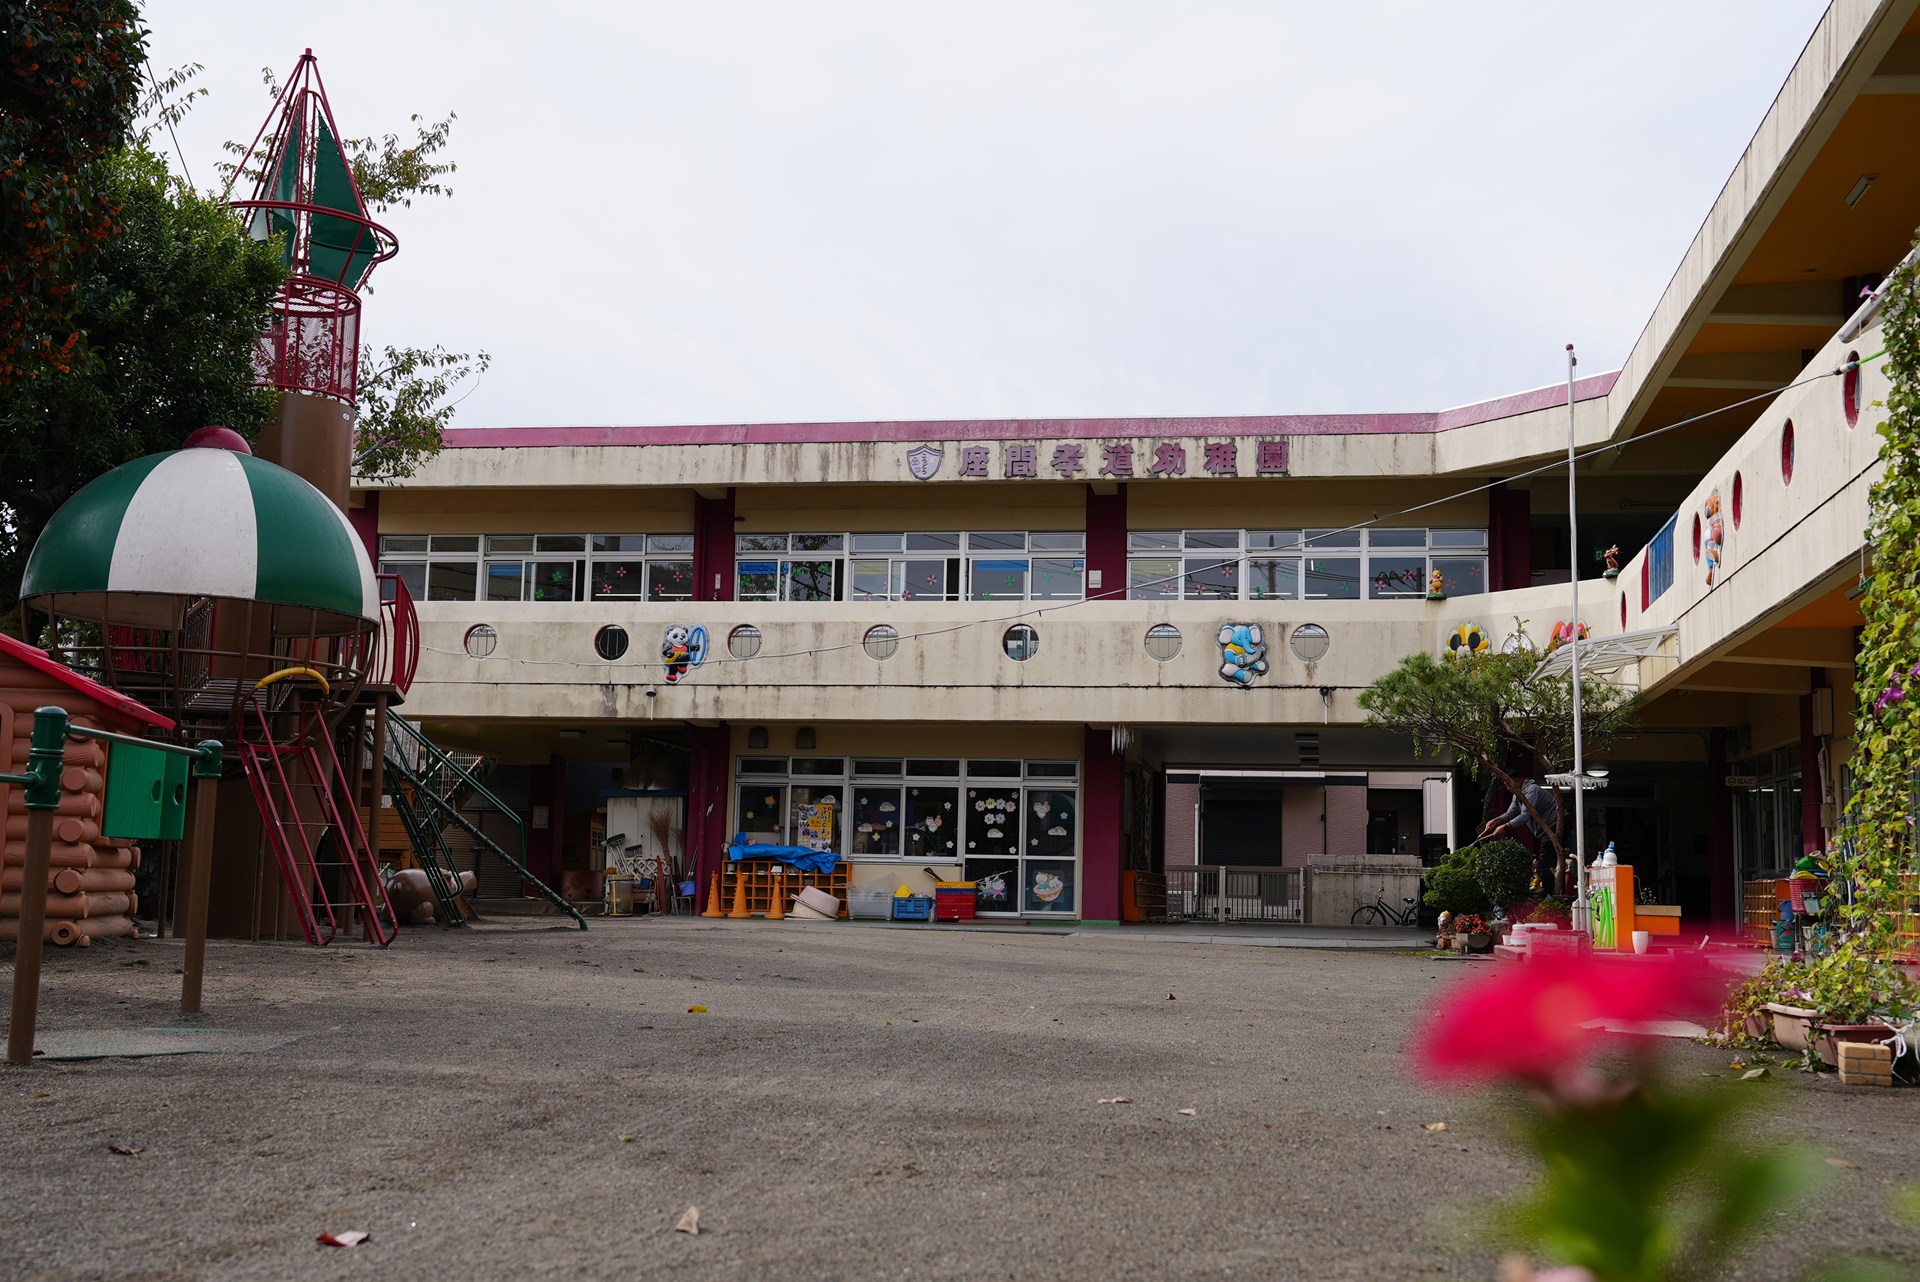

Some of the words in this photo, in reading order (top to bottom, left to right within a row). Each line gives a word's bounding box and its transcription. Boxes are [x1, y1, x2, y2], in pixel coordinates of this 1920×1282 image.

[958, 442, 1289, 478] 座間孝道幼稚園
